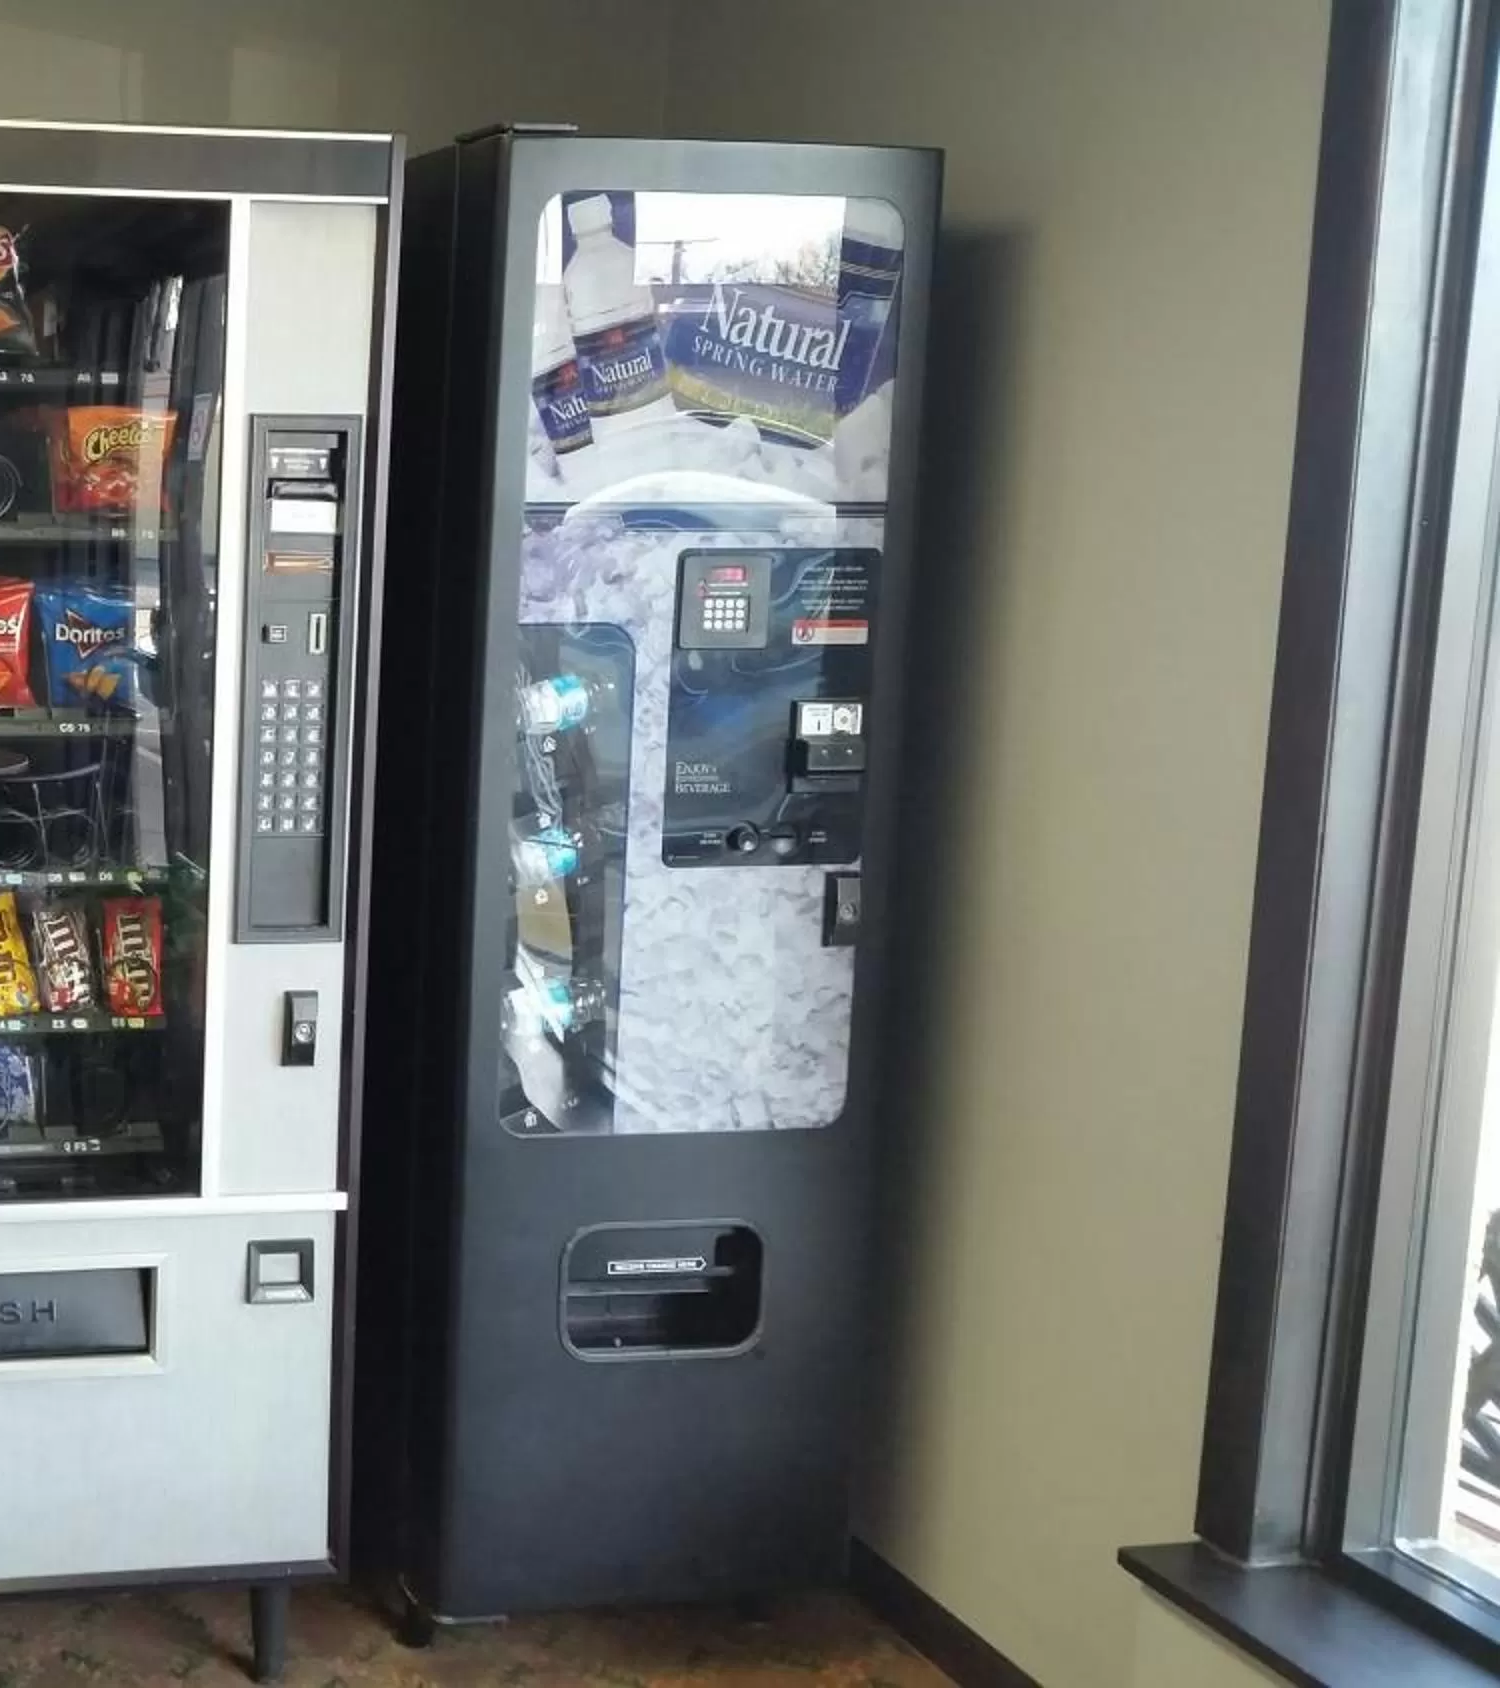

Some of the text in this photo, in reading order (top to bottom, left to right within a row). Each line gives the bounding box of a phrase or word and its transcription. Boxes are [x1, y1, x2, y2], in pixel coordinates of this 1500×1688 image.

[699, 278, 852, 372] Natural
[591, 346, 653, 390] Natural
[692, 335, 840, 393] SPRING WATER
[55, 623, 125, 645] Doritos
